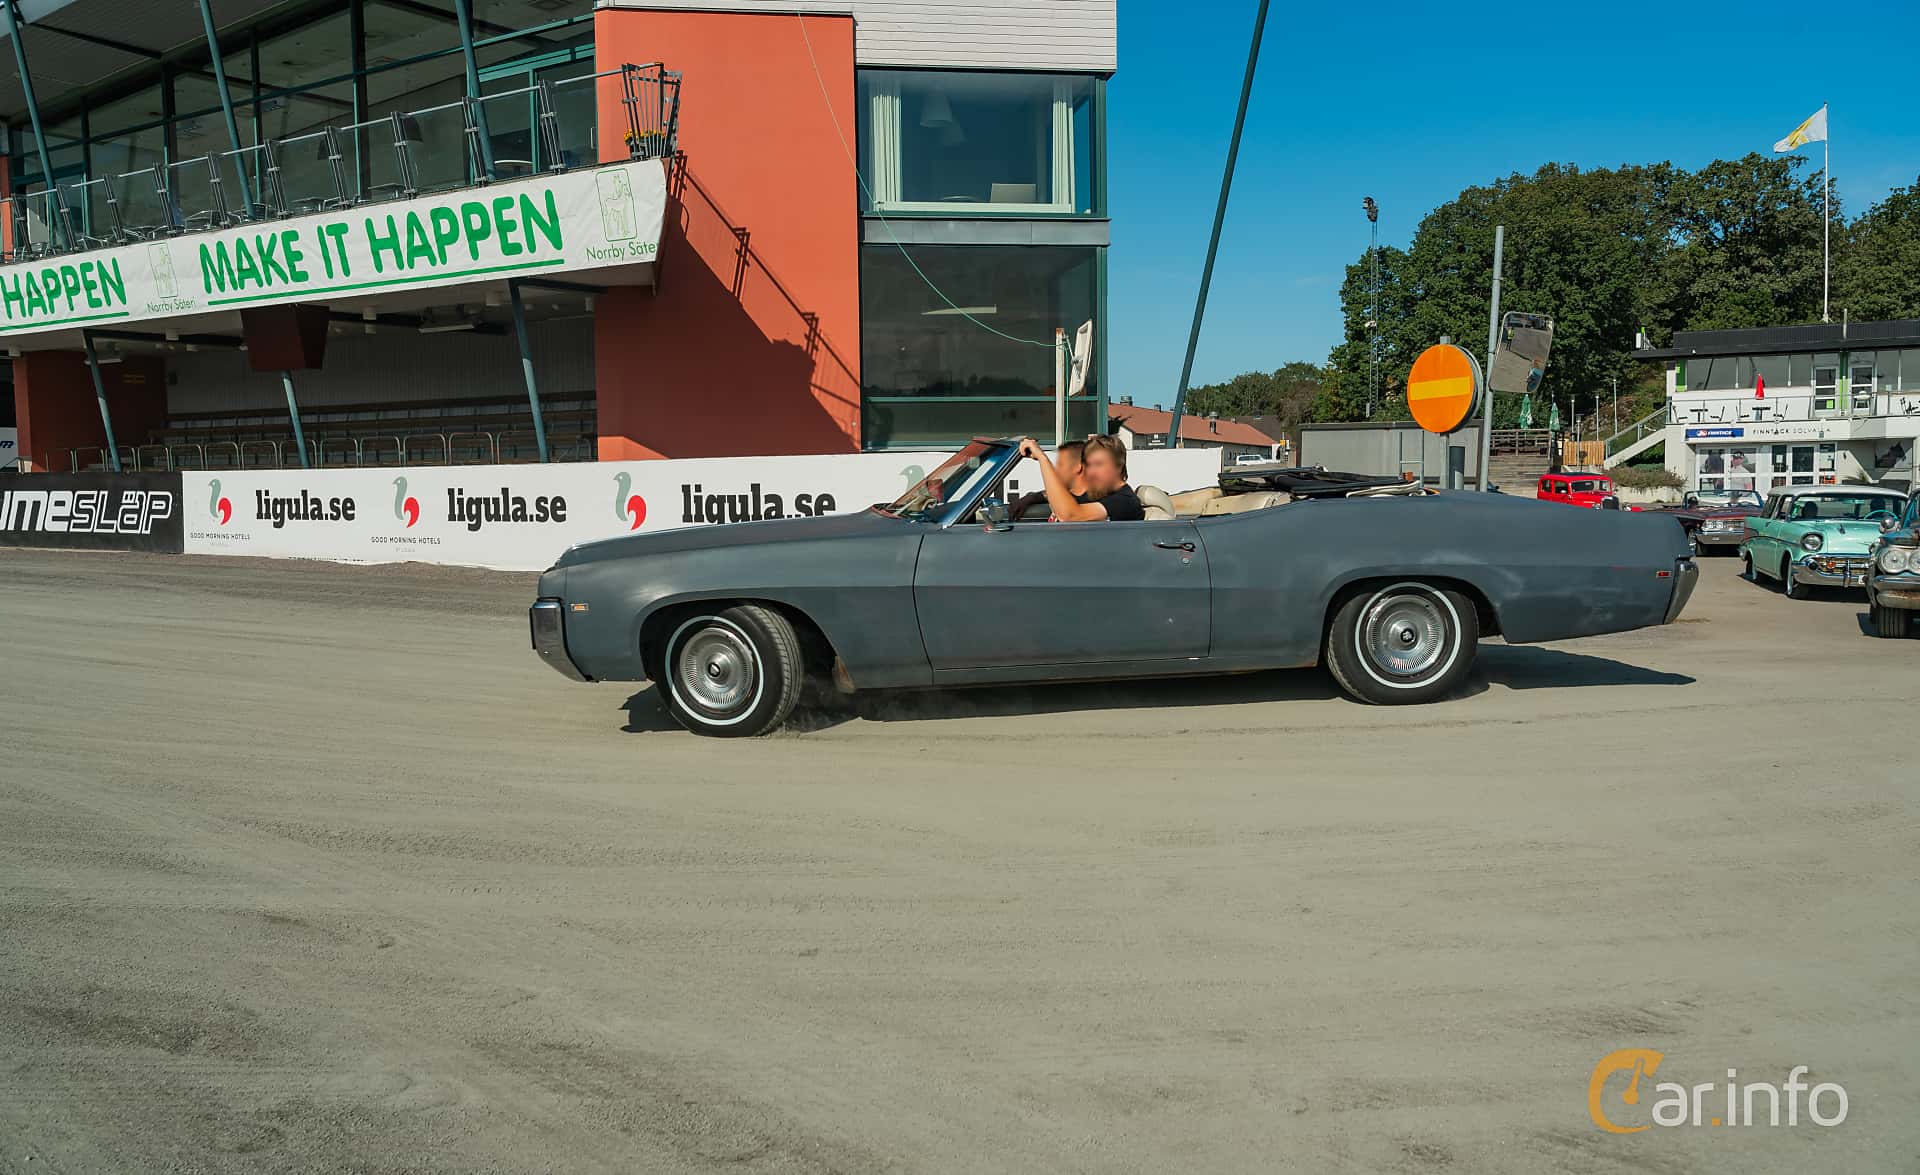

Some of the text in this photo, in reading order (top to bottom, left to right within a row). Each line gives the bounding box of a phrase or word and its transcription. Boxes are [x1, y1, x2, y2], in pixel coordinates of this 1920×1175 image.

[200, 188, 563, 294] MAKE IT HAPPEN
[586, 241, 658, 261] Norrby Säte
[0, 256, 128, 320] HAPPEN
[255, 489, 356, 529] ligula.se
[447, 487, 567, 532] ligula.se
[681, 482, 836, 525] ligula.se
[389, 536, 416, 544] MORNING
[419, 536, 441, 545] HOTELS
